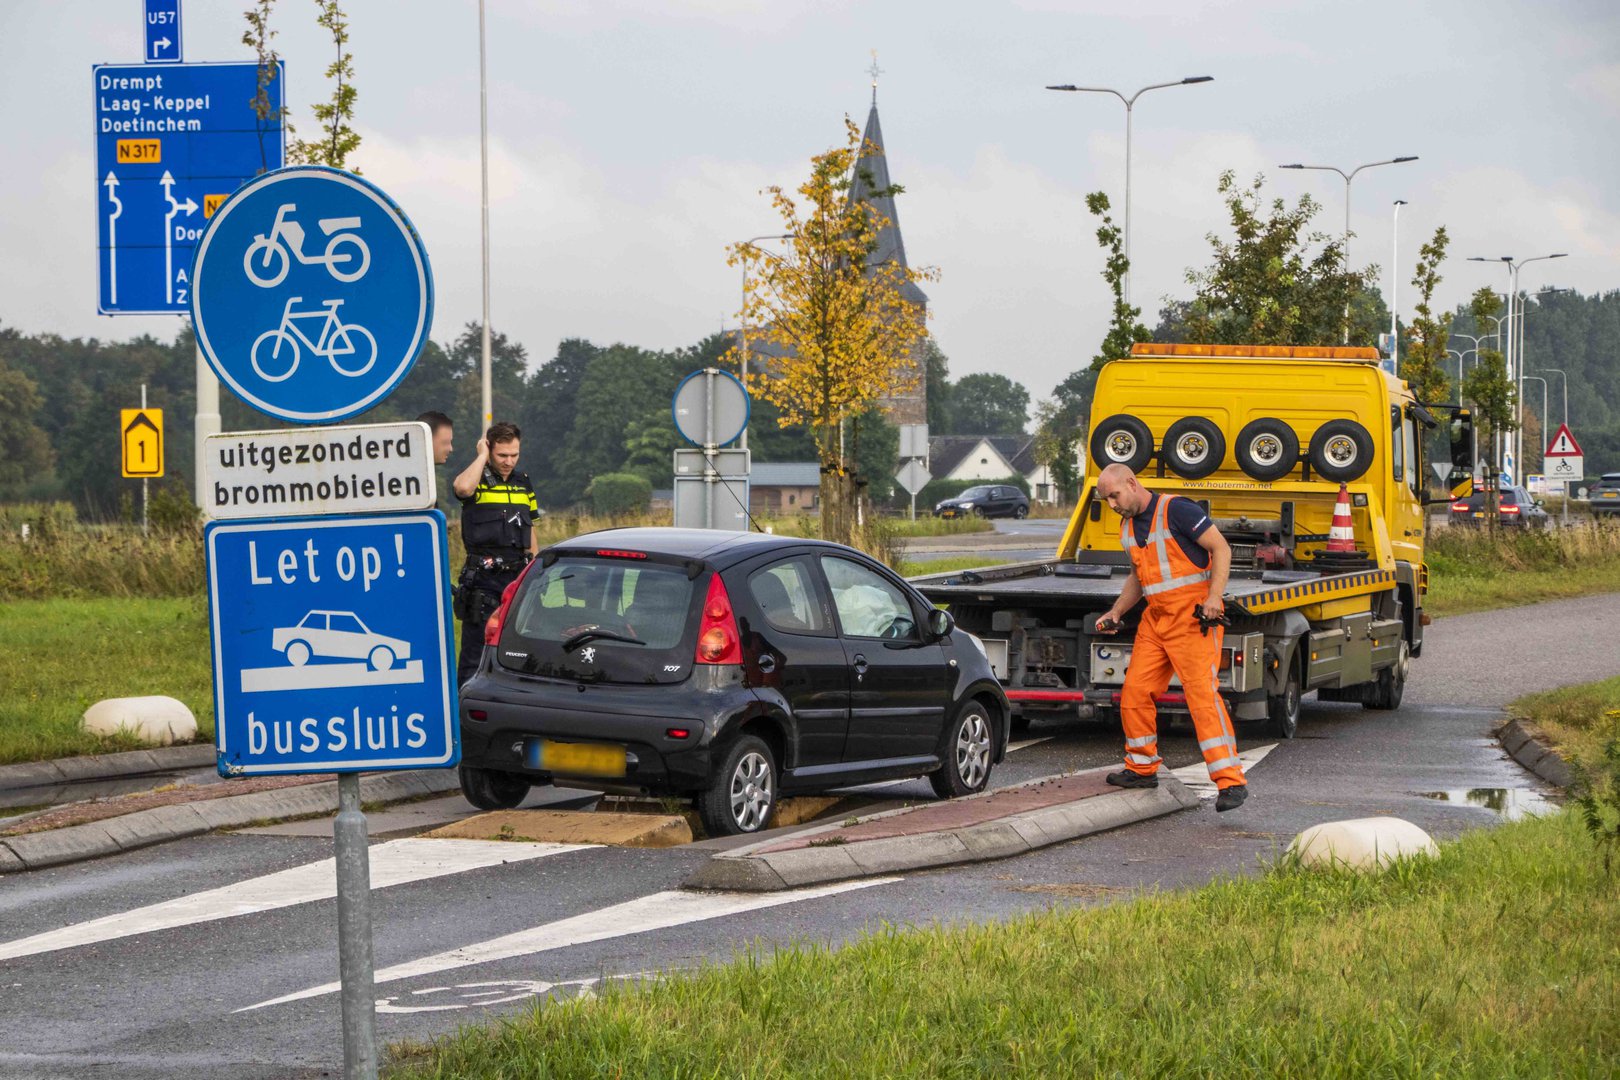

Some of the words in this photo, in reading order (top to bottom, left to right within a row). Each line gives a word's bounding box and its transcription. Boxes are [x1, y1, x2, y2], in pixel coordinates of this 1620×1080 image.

[148, 11, 176, 25] U57
[100, 75, 162, 92] Drempt
[101, 117, 202, 133] Doetinchem
[138, 440, 145, 463] 1
[219, 432, 411, 473] uitgezonderd
[214, 472, 421, 506] brommobielen
[1182, 480, 1273, 490] www.houterman.net
[249, 538, 321, 586] Let
[663, 665, 681, 673] 107
[247, 705, 428, 756] bussluis
